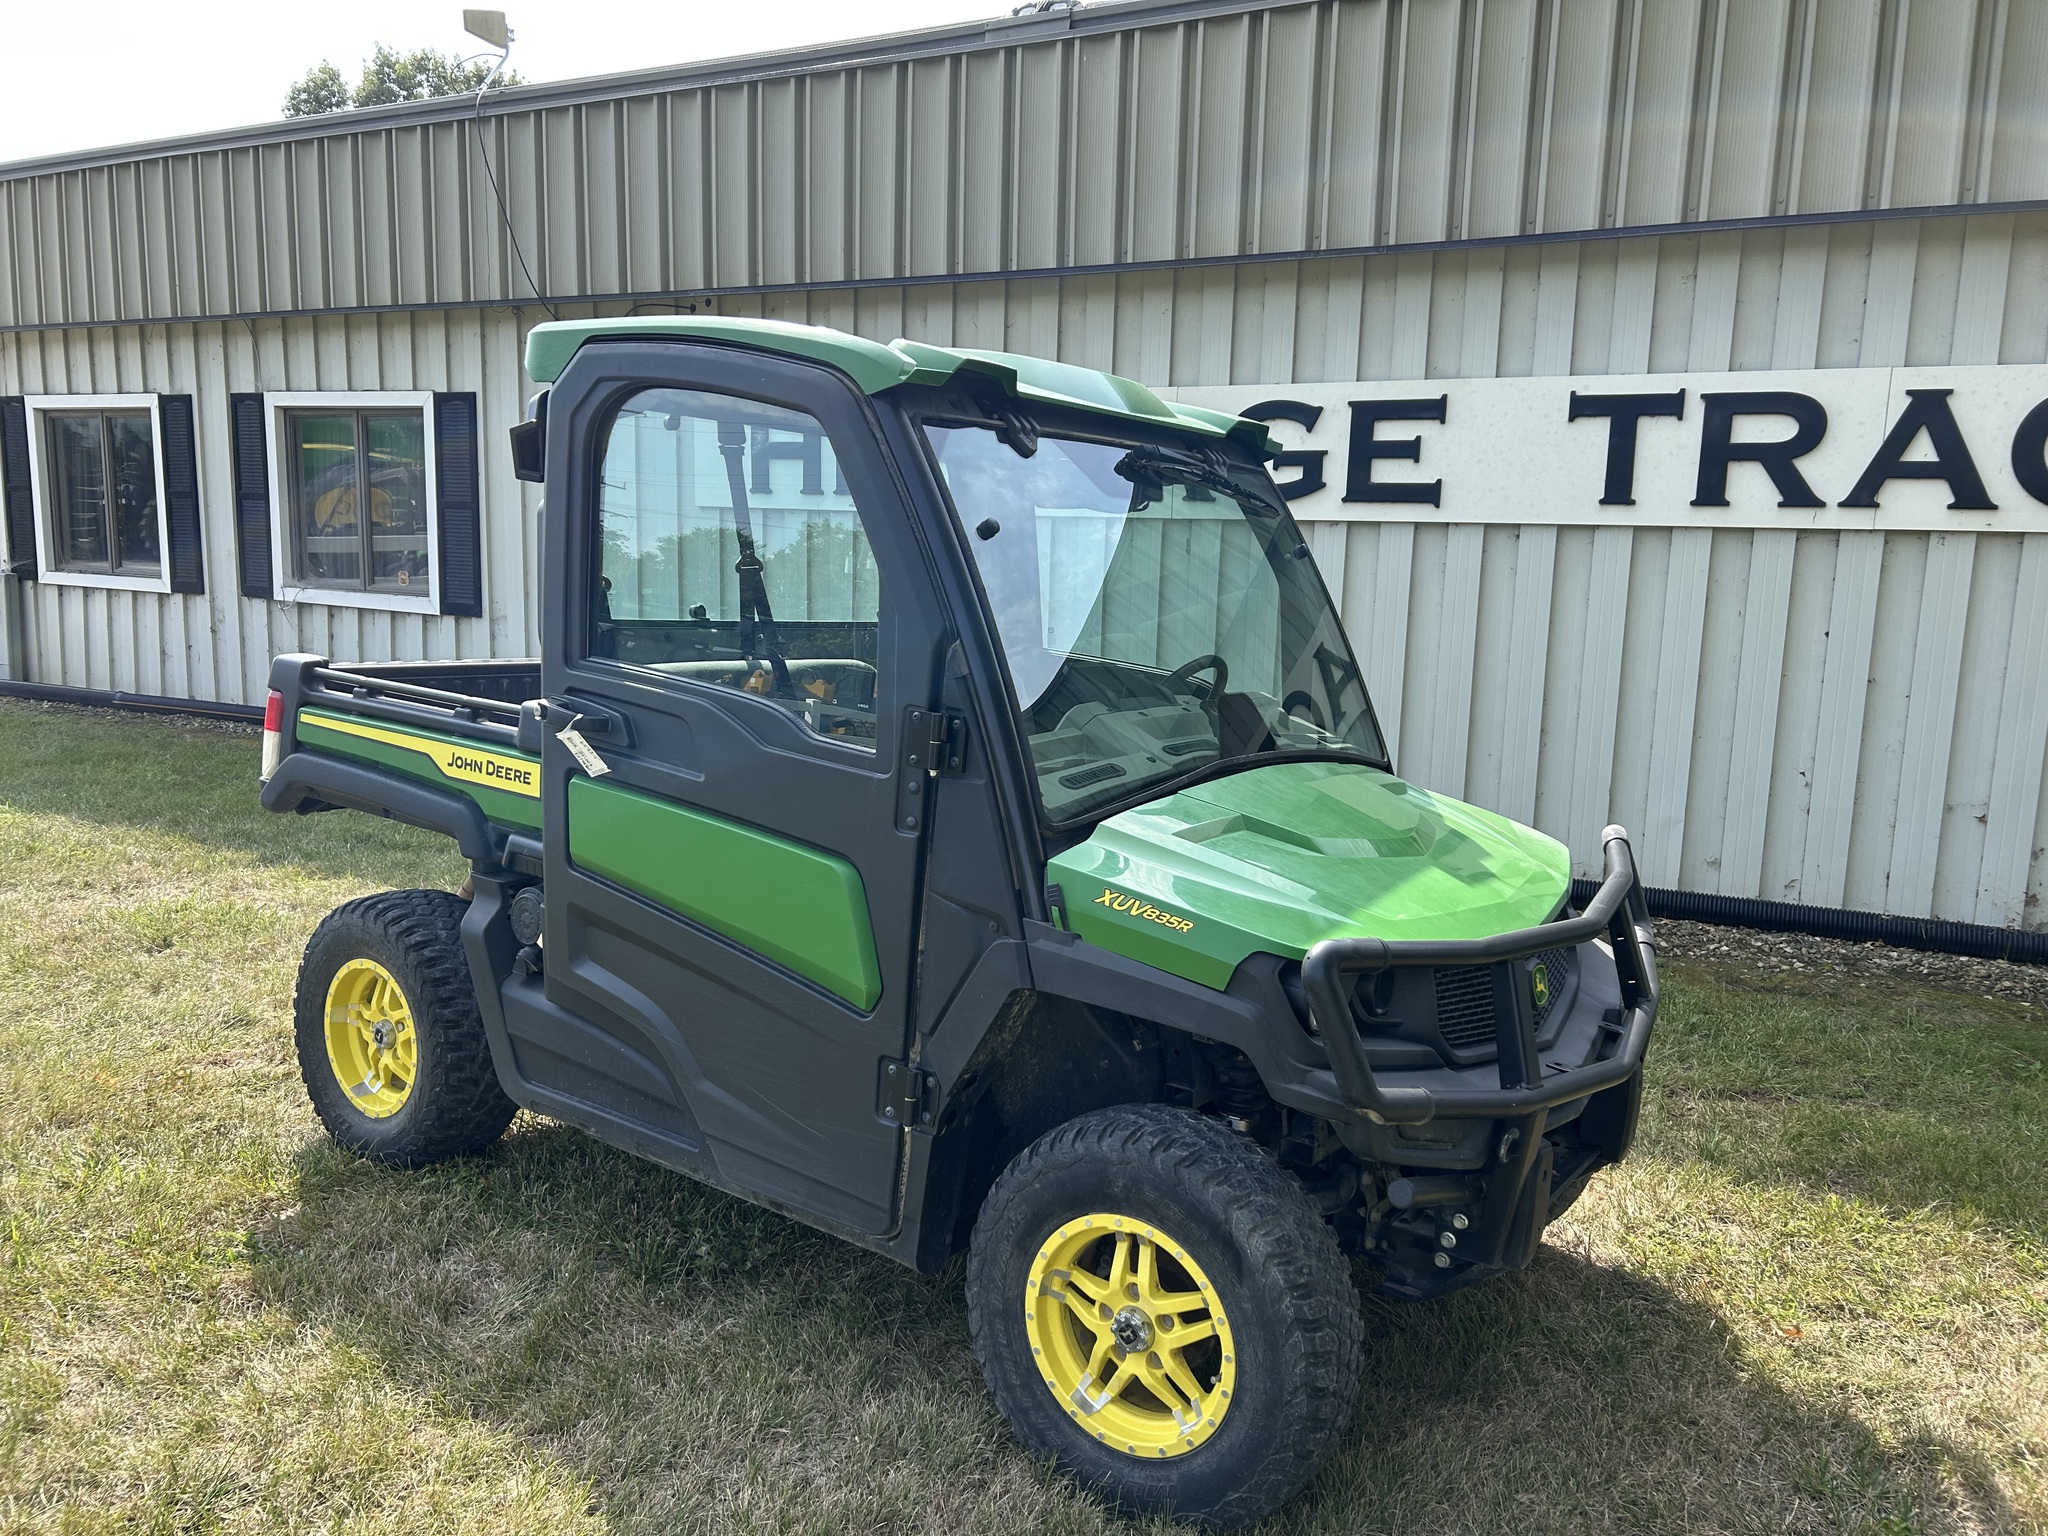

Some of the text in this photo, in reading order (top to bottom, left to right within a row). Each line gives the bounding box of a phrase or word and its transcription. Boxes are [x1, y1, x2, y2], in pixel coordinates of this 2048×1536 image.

[447, 752, 532, 786] JOHN DEERE
[1091, 887, 1195, 934] XUV835R
